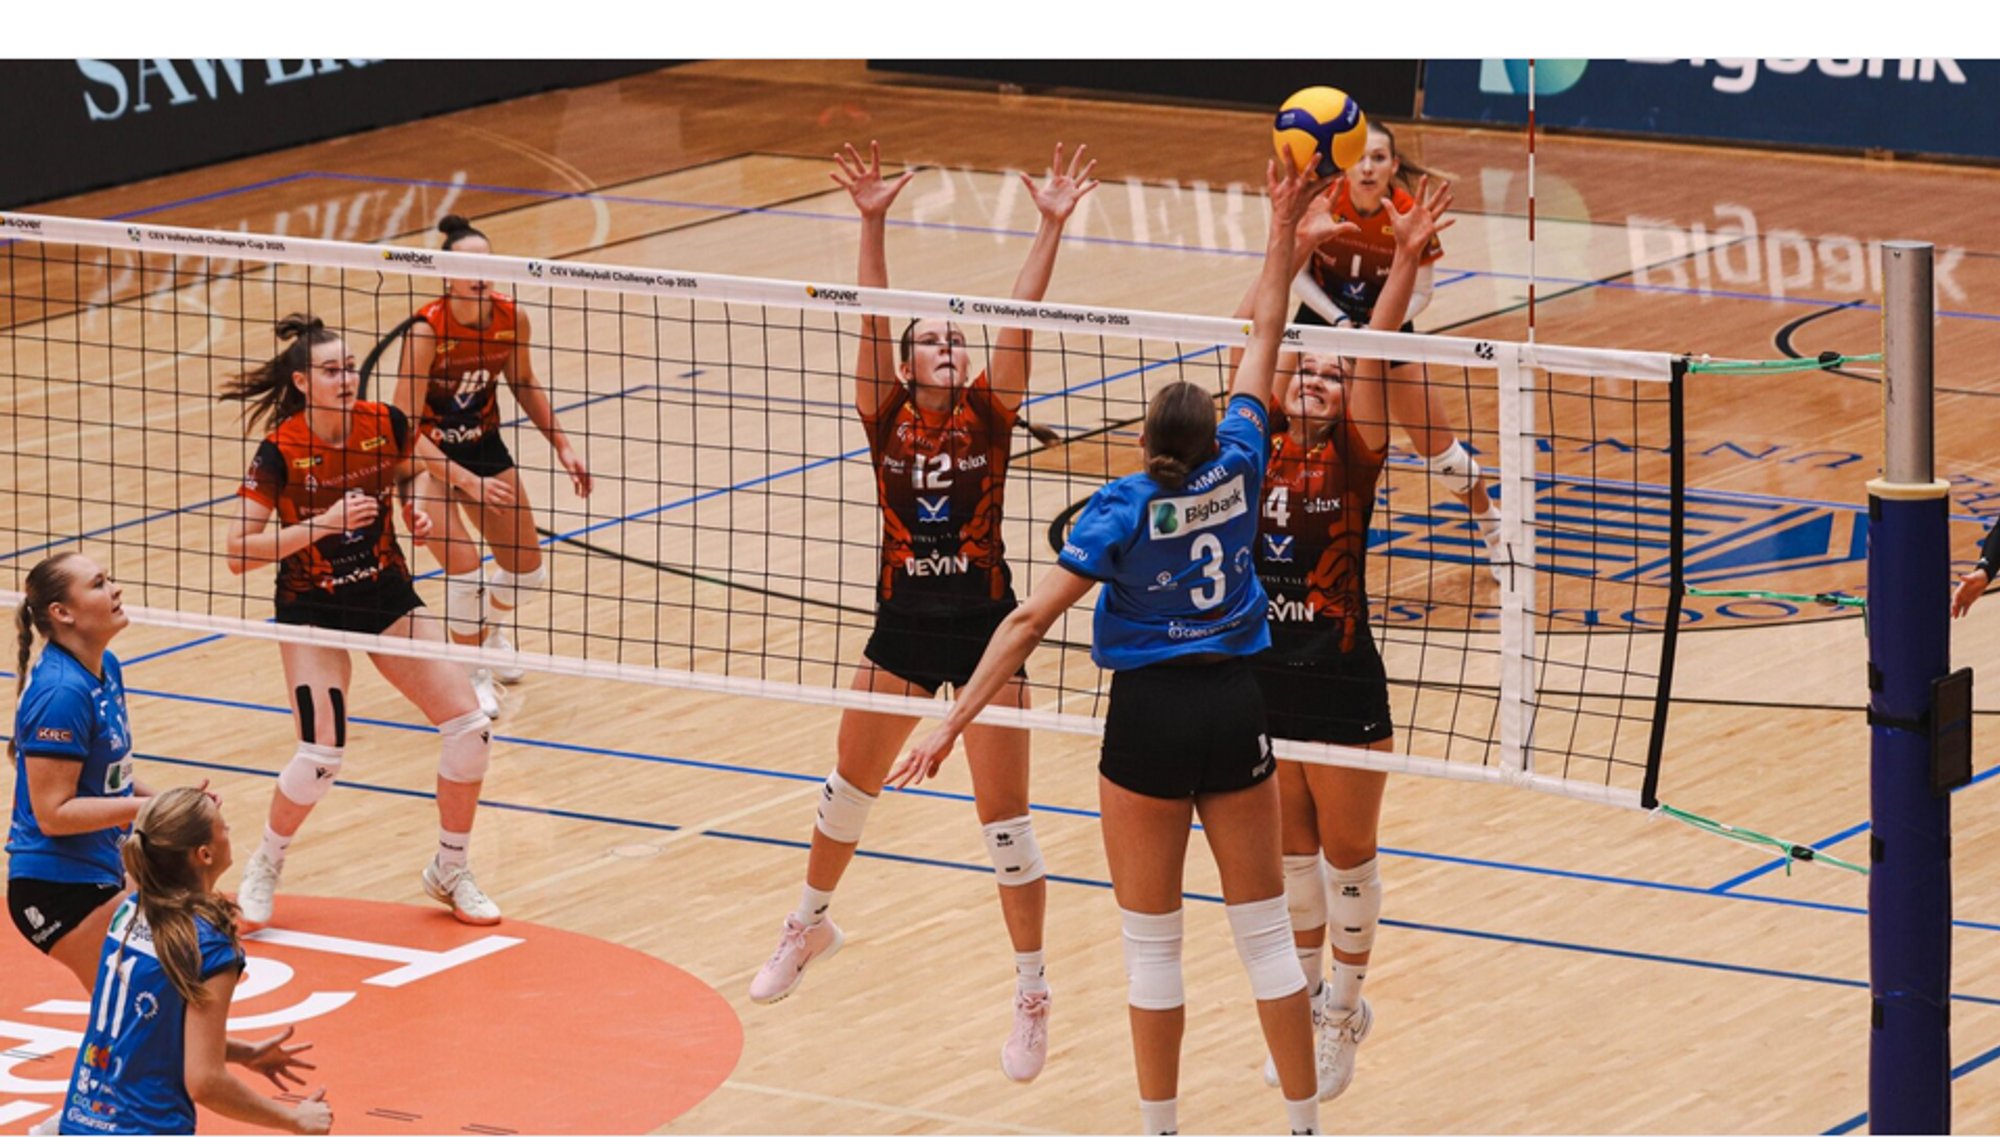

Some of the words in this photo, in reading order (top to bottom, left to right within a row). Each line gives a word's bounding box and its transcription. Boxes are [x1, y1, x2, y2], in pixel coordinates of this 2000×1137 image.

[148, 231, 164, 240] CEV
[166, 232, 206, 245] Volleyball
[206, 235, 246, 248] Challenge
[247, 239, 265, 251] Cup
[266, 240, 286, 251] 2025
[393, 251, 434, 264] weber
[550, 266, 568, 276] CEV
[570, 268, 611, 282] Volleyball
[612, 271, 655, 285] Challenge
[656, 275, 675, 288] Cup
[676, 278, 698, 289] 2025
[818, 288, 859, 300] isover
[972, 304, 992, 314] CEV
[994, 305, 1038, 320] Volleyball
[1039, 308, 1085, 323] Challenge
[1087, 312, 1106, 326] Cup
[1107, 313, 1130, 325] 2025
[911, 452, 953, 489] 12
[1184, 489, 1243, 524] Bigbank
[1190, 532, 1226, 610] 3
[1266, 600, 1315, 623] EVIN
[96, 949, 138, 1039] 11
